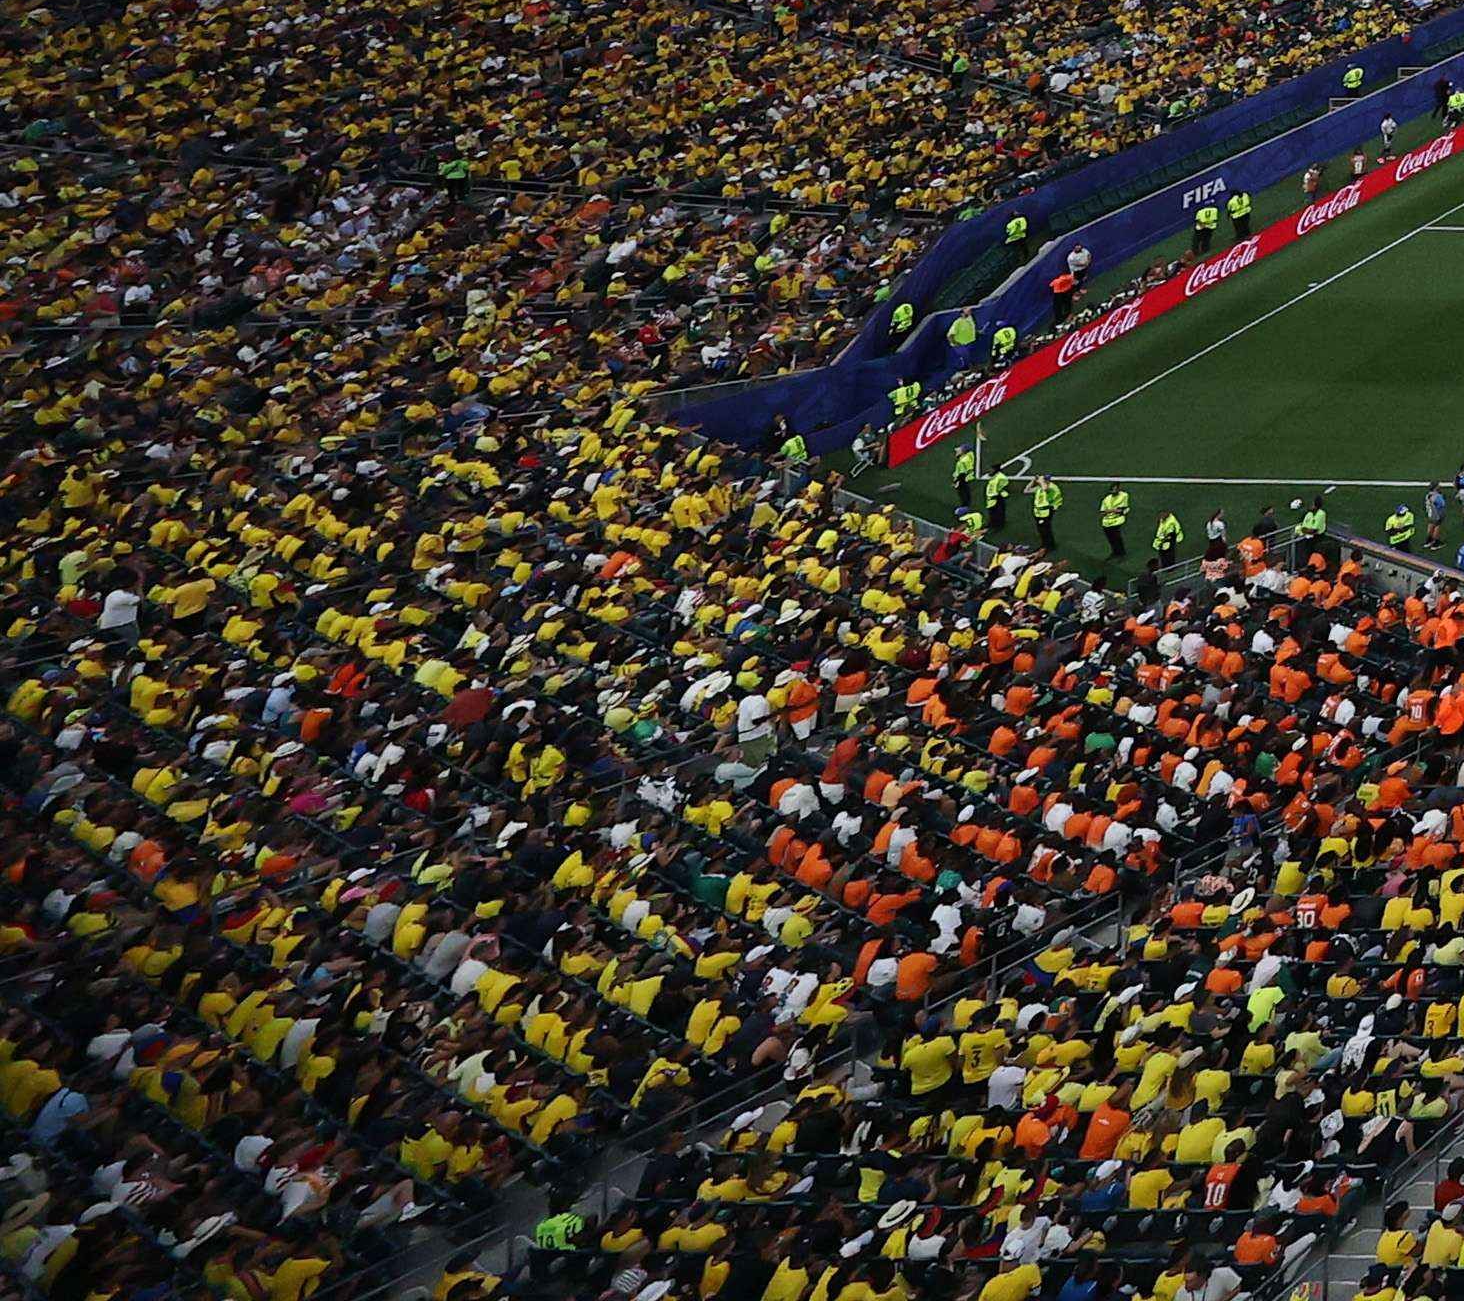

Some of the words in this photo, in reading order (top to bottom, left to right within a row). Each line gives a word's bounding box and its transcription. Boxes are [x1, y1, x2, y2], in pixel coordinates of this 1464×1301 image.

[1396, 131, 1457, 182] Coca-Cola
[1182, 176, 1227, 210] FIFA
[1296, 180, 1364, 236] Coca-Cola
[1185, 235, 1261, 297] Coca-Cola
[1057, 299, 1145, 367] Coca-Cola
[915, 370, 1013, 450] Coca-Cola
[969, 1045, 982, 1068] 3
[1206, 1182, 1225, 1206] 10
